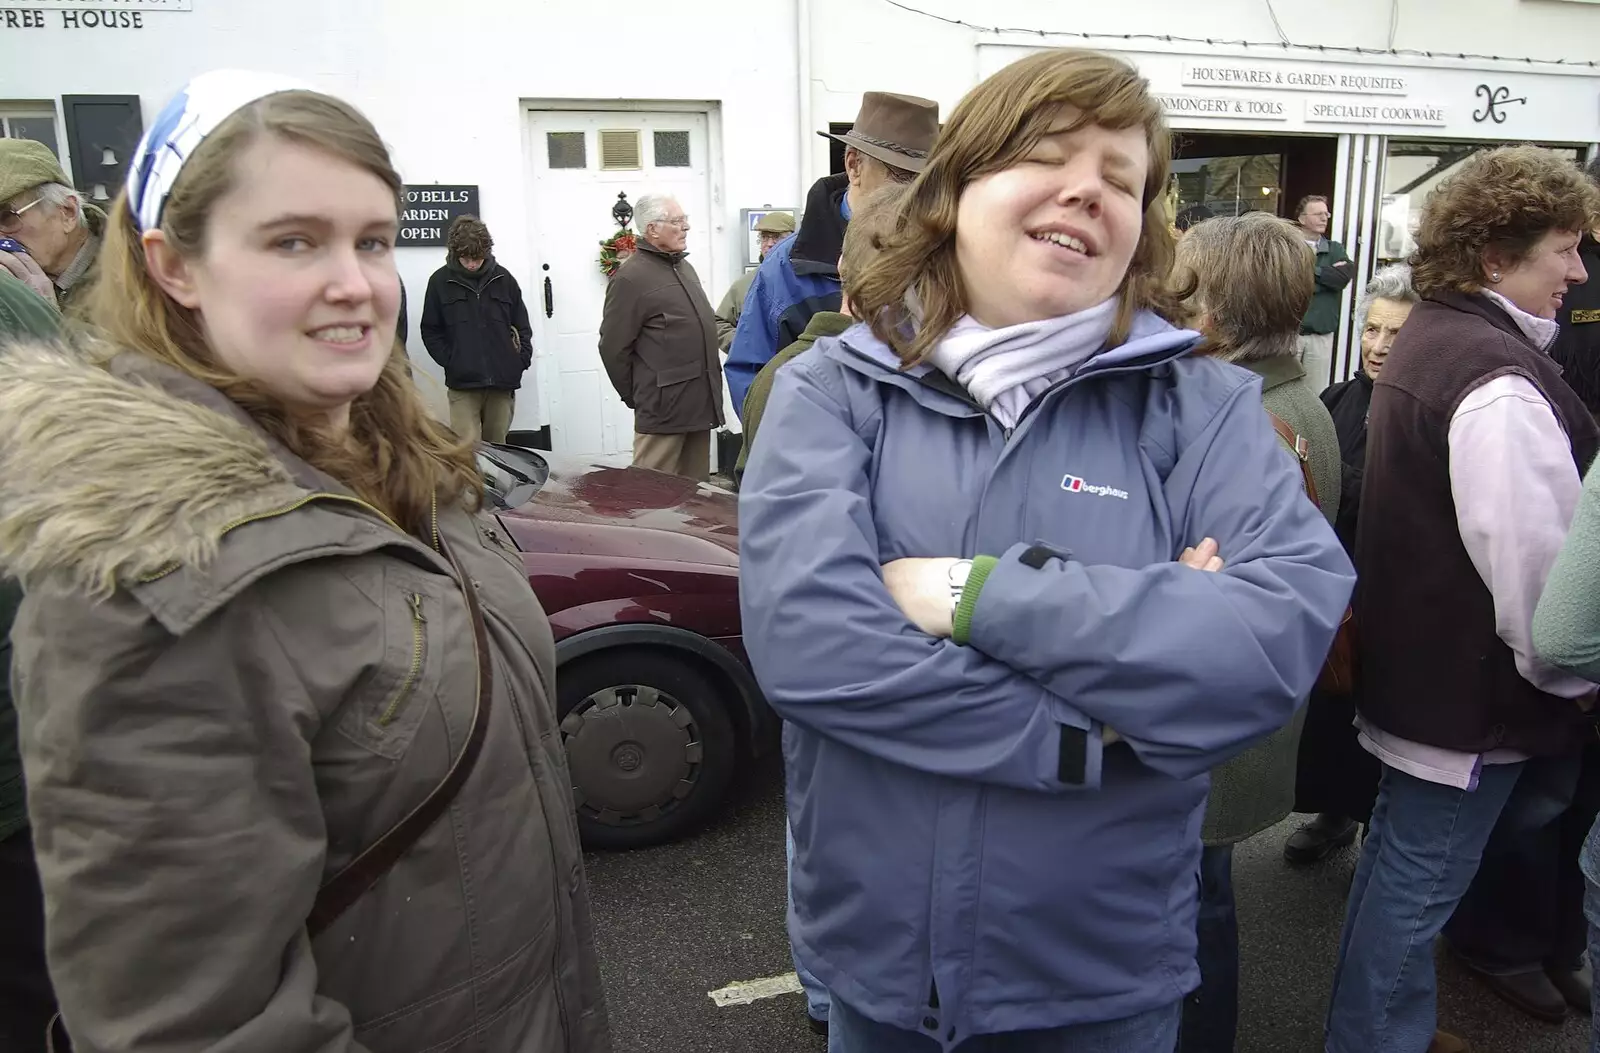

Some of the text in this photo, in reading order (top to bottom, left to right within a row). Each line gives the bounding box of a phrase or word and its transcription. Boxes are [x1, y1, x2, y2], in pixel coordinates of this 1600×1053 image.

[62, 10, 143, 29] HOUSE
[1192, 67, 1404, 90] HOUSEWARES & GARDEN REQUISITES
[1155, 97, 1283, 114] NMONGERY & TOOLS
[1313, 104, 1443, 121] SPECIALIST COOKWARE
[400, 209, 449, 221] ARDEN
[401, 227, 440, 239] OPEN
